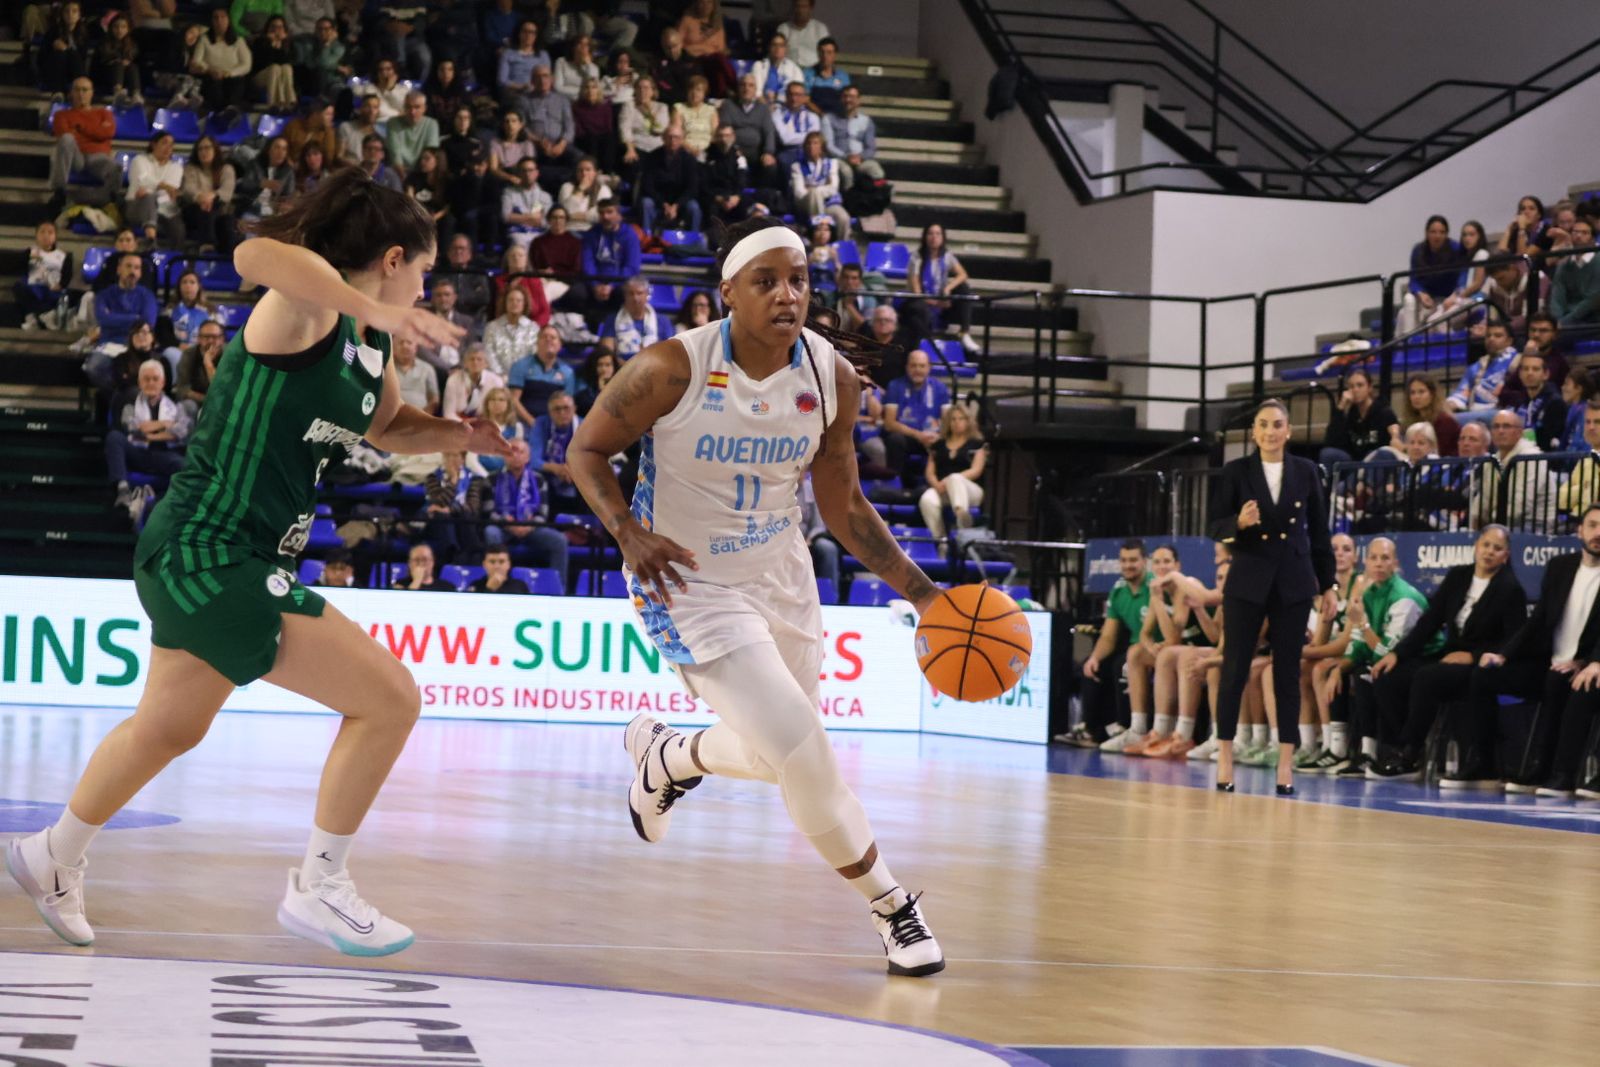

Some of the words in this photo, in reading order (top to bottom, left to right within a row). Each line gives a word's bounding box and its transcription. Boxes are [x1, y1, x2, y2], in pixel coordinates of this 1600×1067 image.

[694, 434, 811, 464] AVENIDA
[733, 473, 760, 511] 11
[514, 688, 696, 713] INDUSTRIALES
